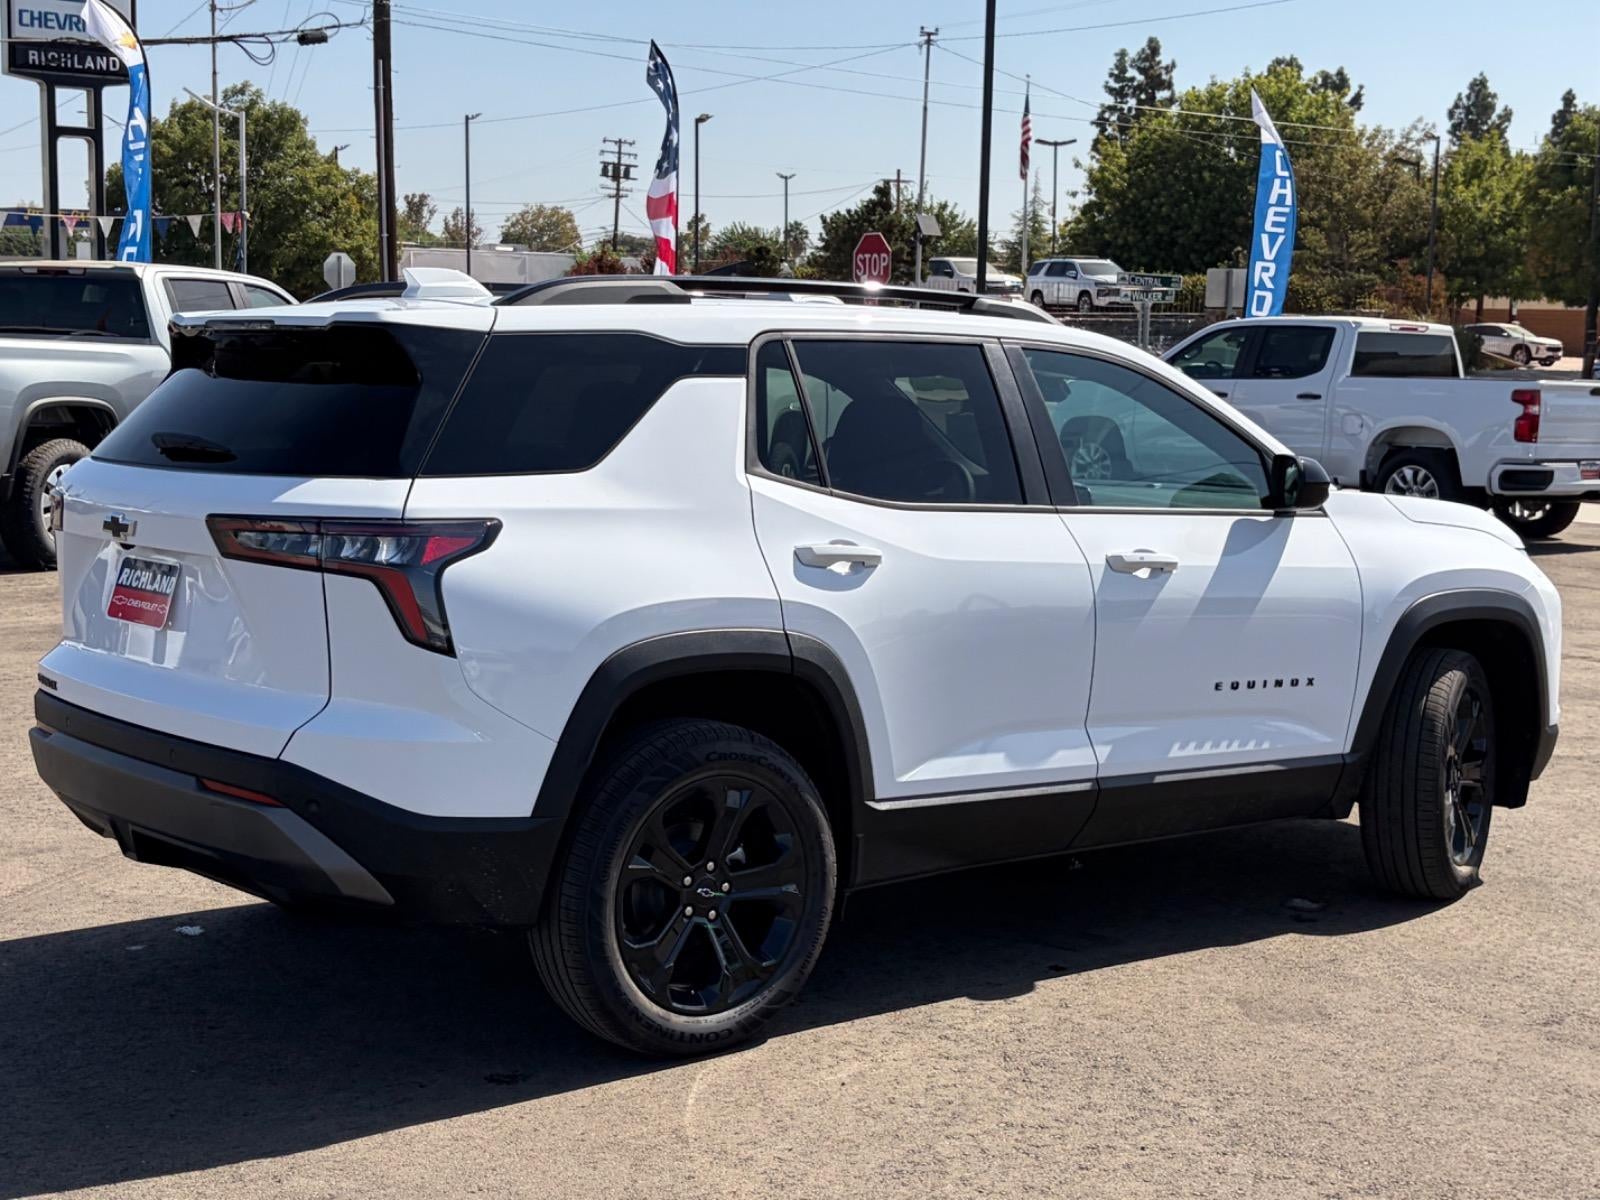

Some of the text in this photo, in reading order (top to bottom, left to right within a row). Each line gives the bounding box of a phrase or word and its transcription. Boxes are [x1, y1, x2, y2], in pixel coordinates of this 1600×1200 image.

[28, 50, 120, 71] RICHLAND
[856, 253, 888, 276] STOP
[118, 567, 176, 594] RICHLAND
[1214, 677, 1315, 691] EQUINOX
